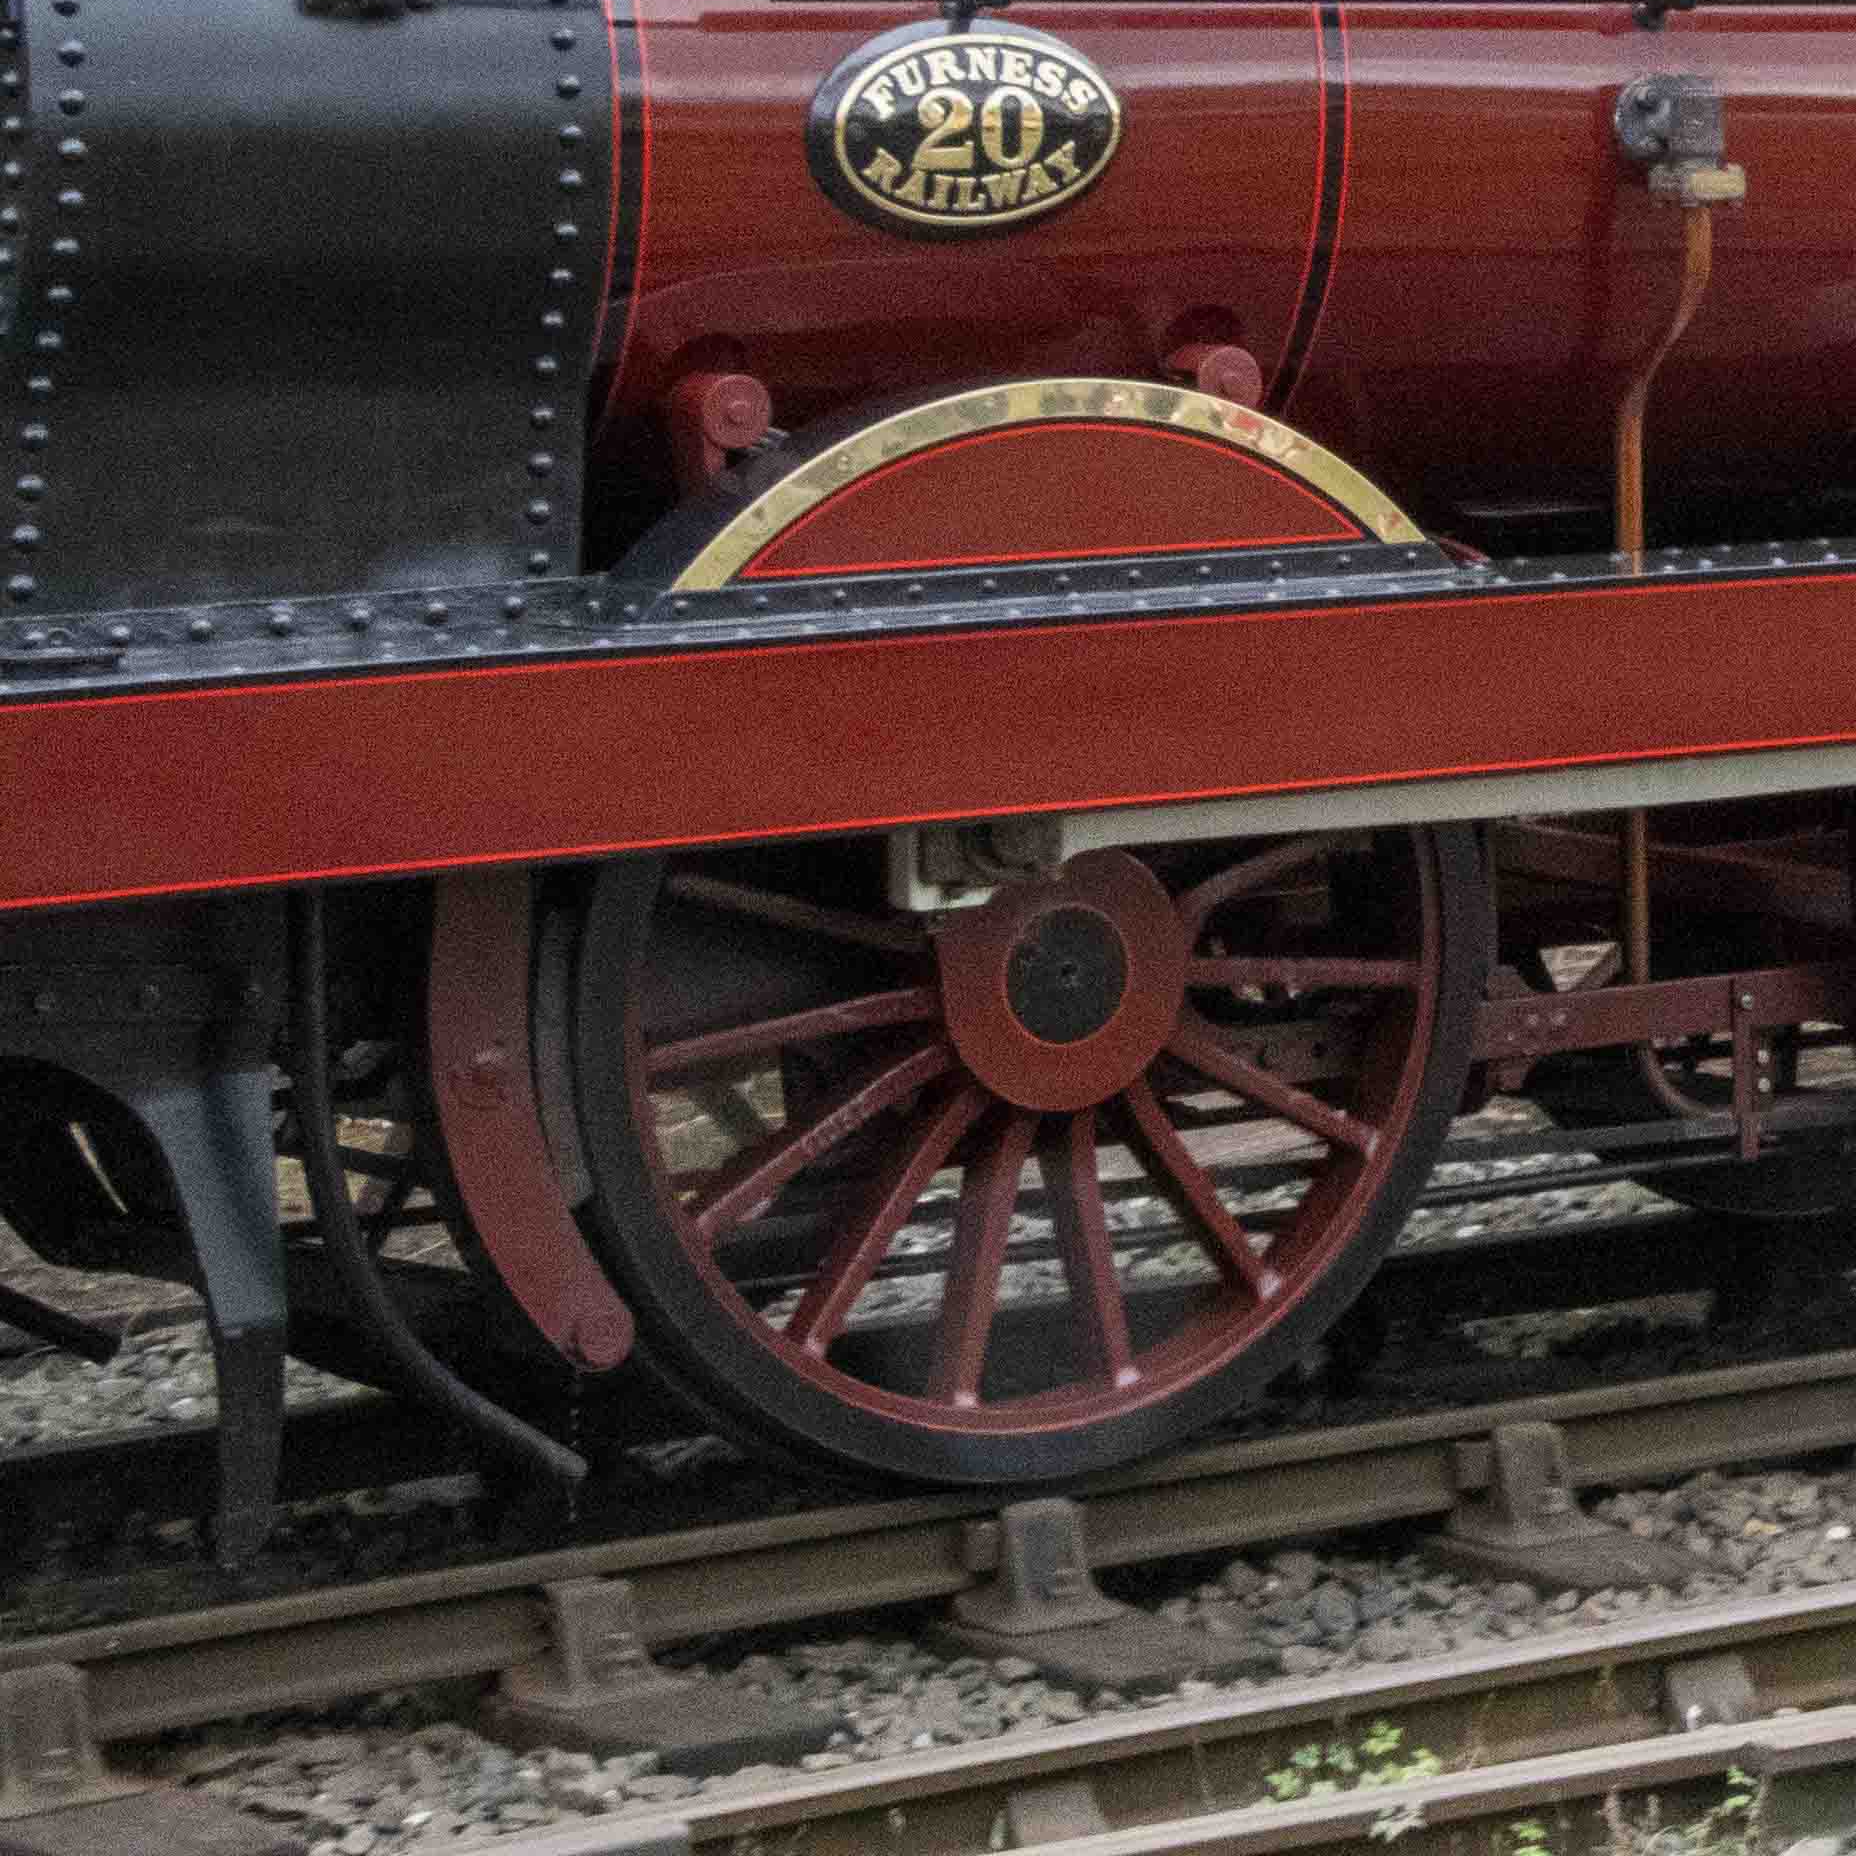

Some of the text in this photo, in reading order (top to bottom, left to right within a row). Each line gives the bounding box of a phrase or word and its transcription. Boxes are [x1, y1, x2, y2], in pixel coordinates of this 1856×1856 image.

[861, 46, 1098, 120] FURNESS
[912, 85, 1045, 170] 20
[862, 140, 1082, 211] RAILWAY
